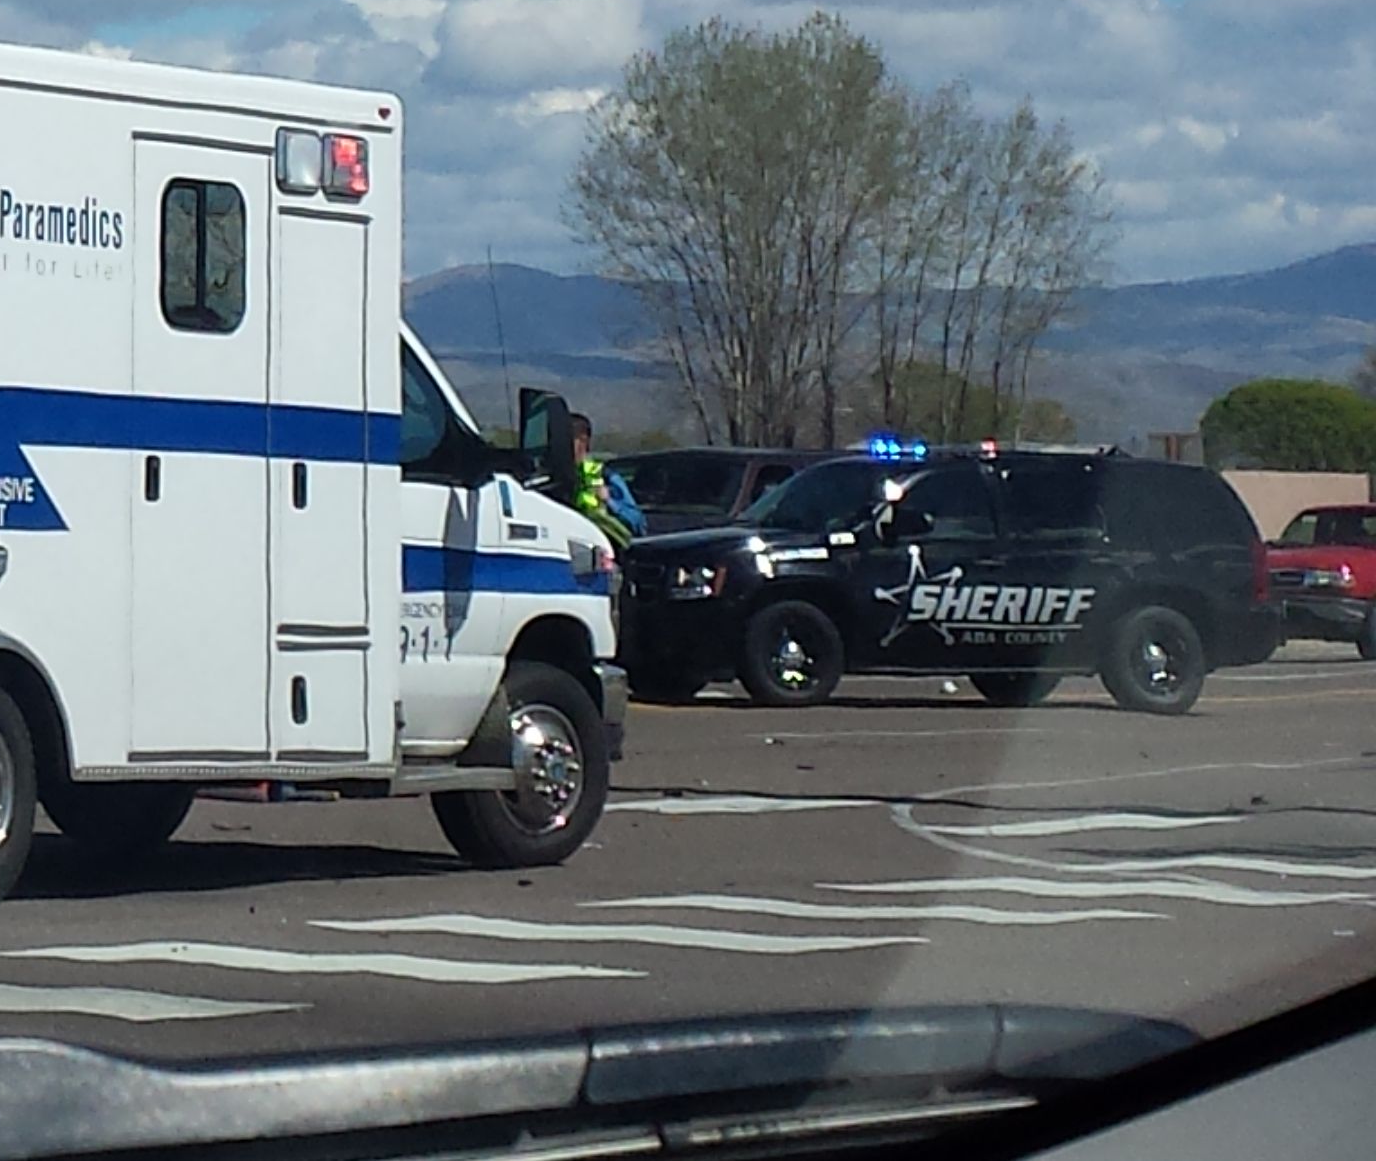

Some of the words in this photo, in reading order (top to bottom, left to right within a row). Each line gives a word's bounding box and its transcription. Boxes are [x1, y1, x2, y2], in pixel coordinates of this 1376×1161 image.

[907, 584, 1096, 623] SHERIFF
[961, 631, 996, 644] ADA
[1005, 631, 1068, 645] COUNTY
